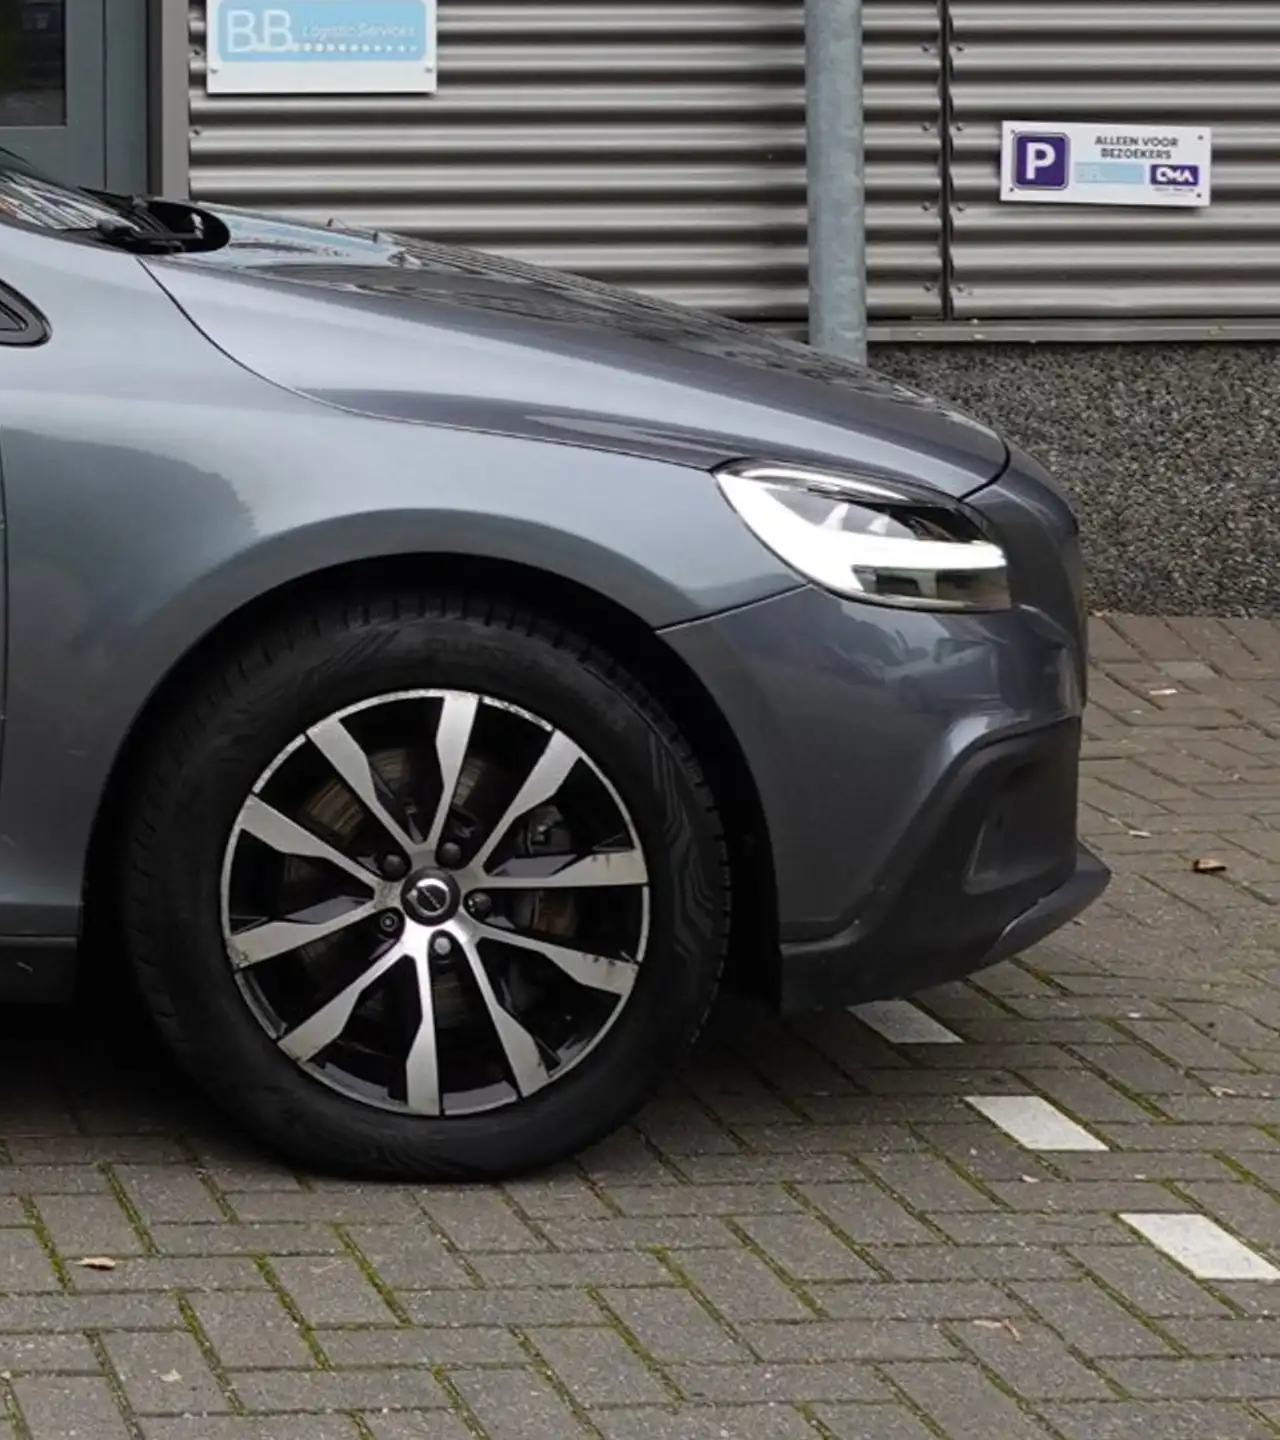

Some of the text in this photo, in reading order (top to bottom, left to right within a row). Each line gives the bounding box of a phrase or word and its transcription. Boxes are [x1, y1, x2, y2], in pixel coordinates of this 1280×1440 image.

[1094, 135, 1179, 148] ALLEEN VOOR
[1100, 148, 1172, 160] BEZOEKERS
[1026, 142, 1056, 180] P
